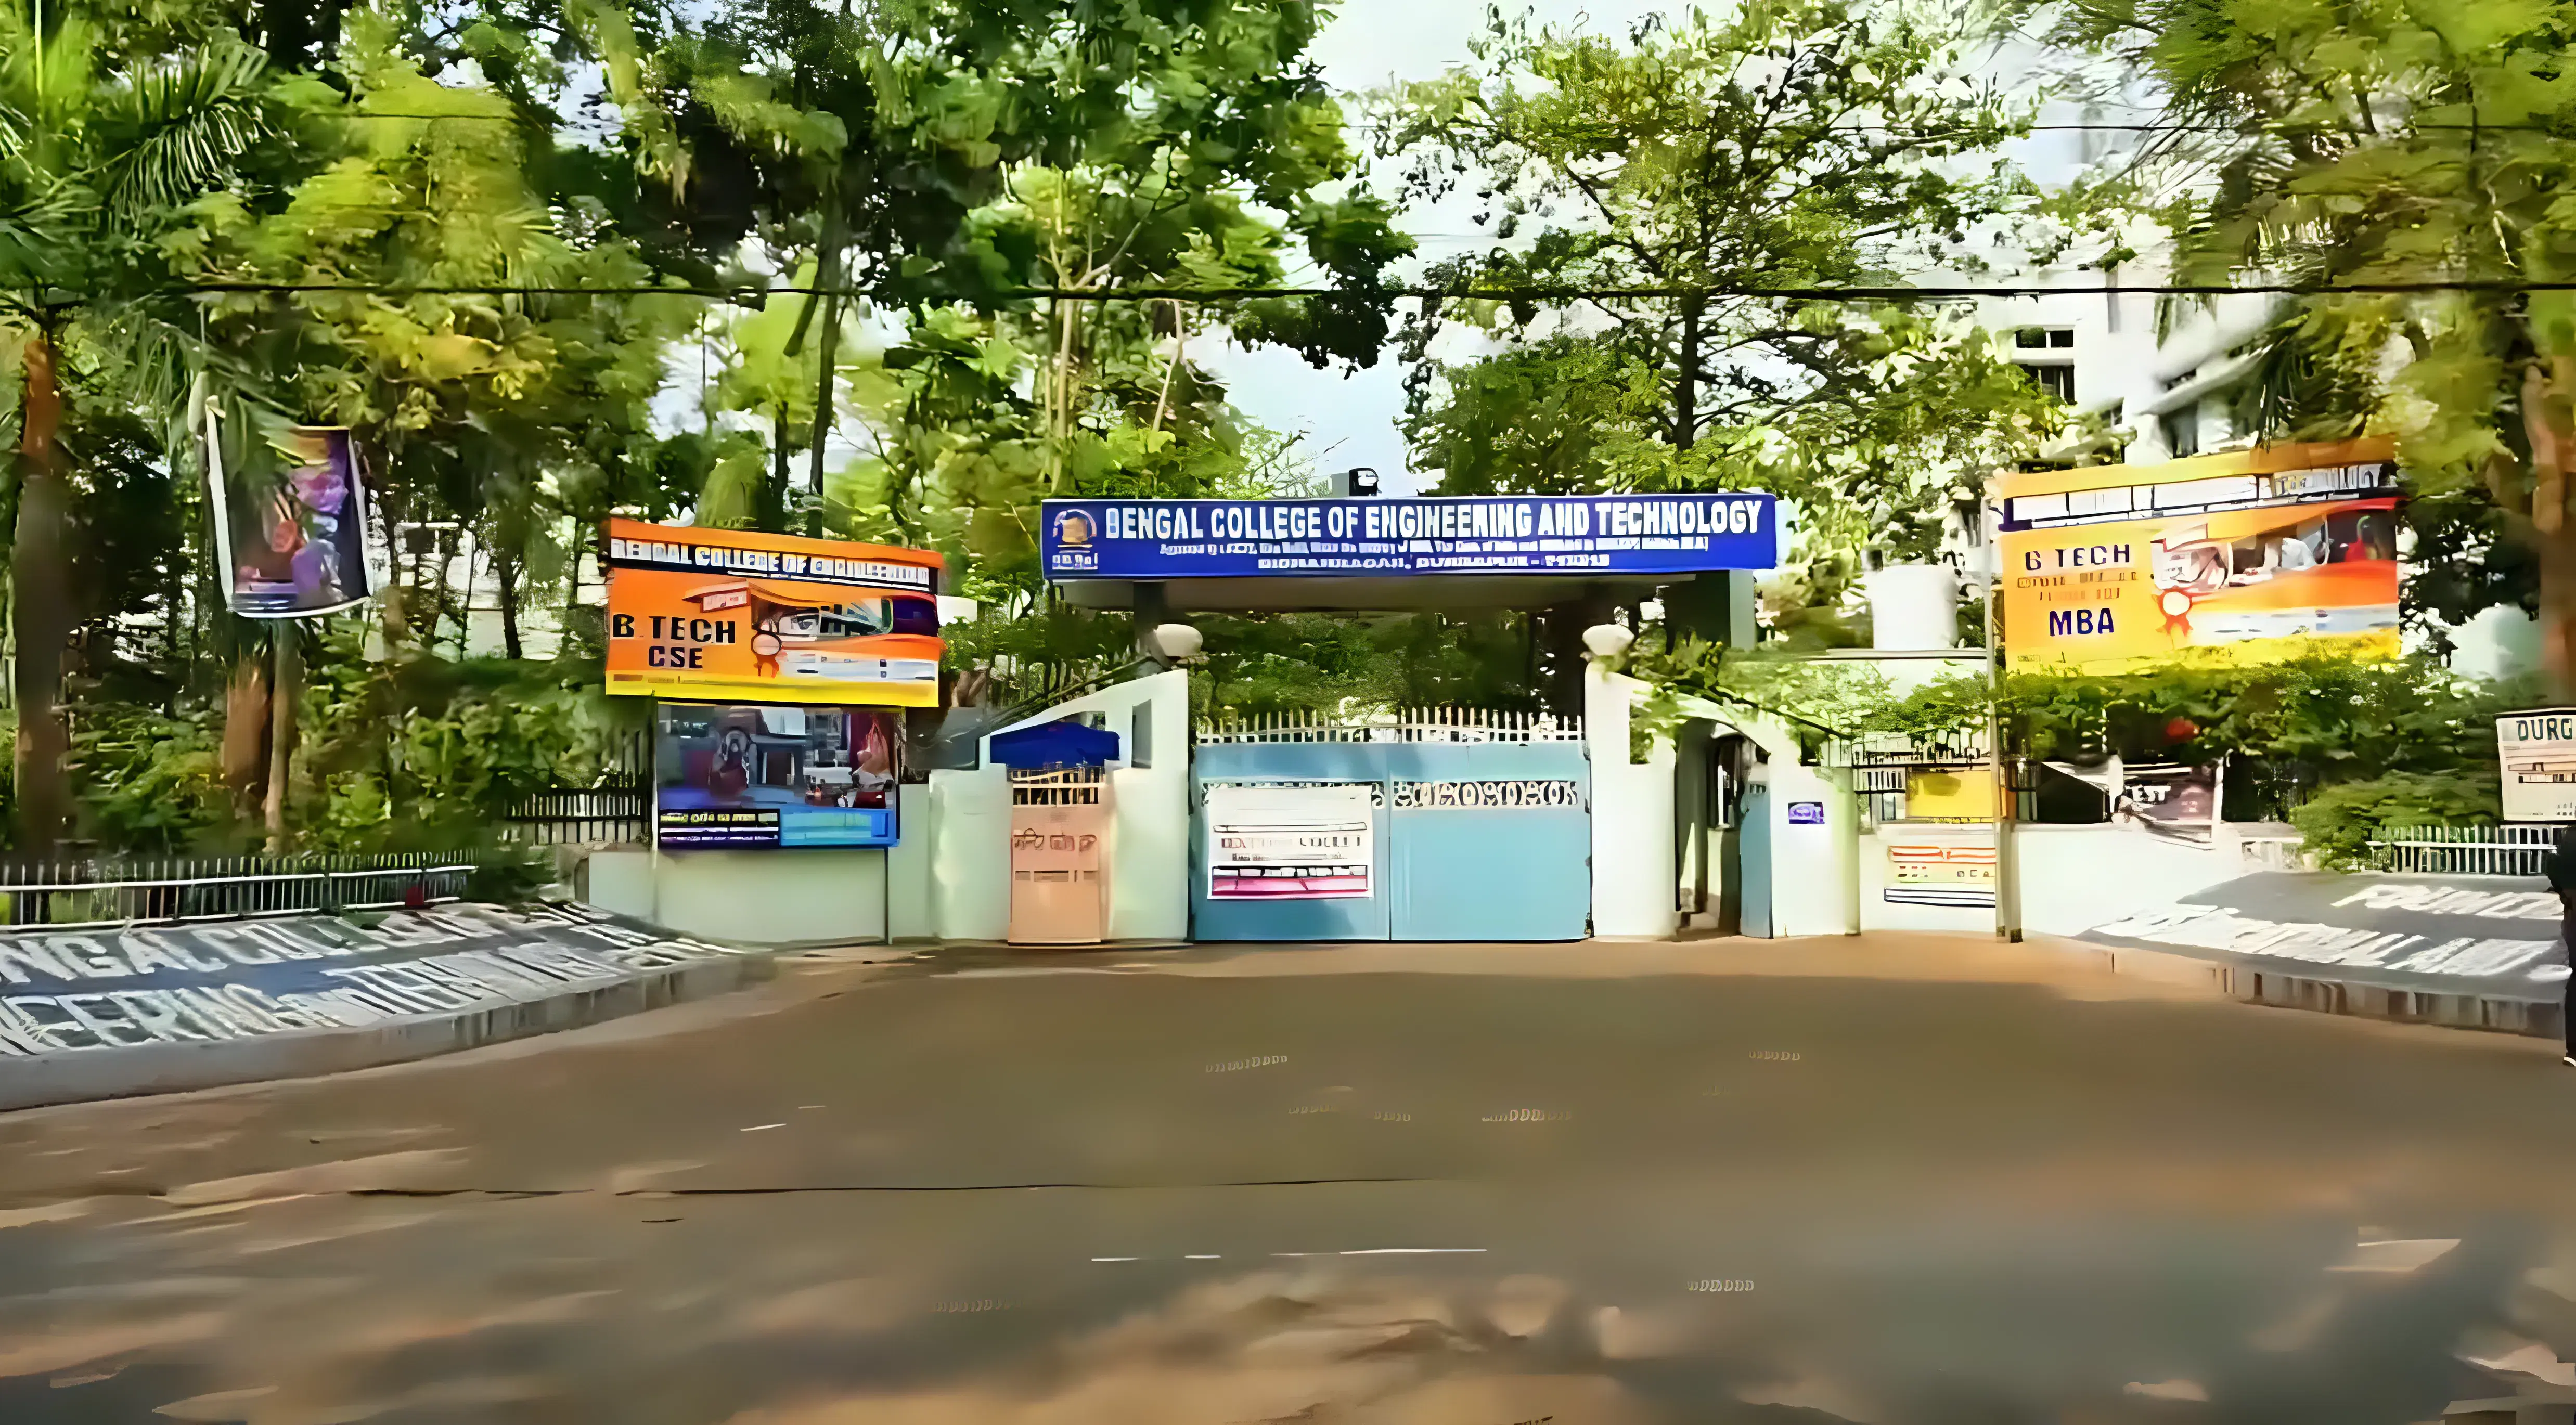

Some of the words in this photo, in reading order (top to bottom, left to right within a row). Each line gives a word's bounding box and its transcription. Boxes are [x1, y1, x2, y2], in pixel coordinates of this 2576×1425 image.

[1105, 506, 1204, 540] BENGAL
[1212, 506, 1321, 539] COLLEGE
[1327, 506, 1358, 539] OF
[1365, 503, 1532, 538] ENGINEERING
[1537, 502, 1589, 536] AND
[1594, 500, 1762, 536] TECHNOLOGY
[2055, 543, 2130, 568] TECH
[613, 613, 635, 638] B
[648, 616, 736, 644] TECH
[2049, 607, 2115, 637] MBA
[648, 645, 703, 669] CSE
